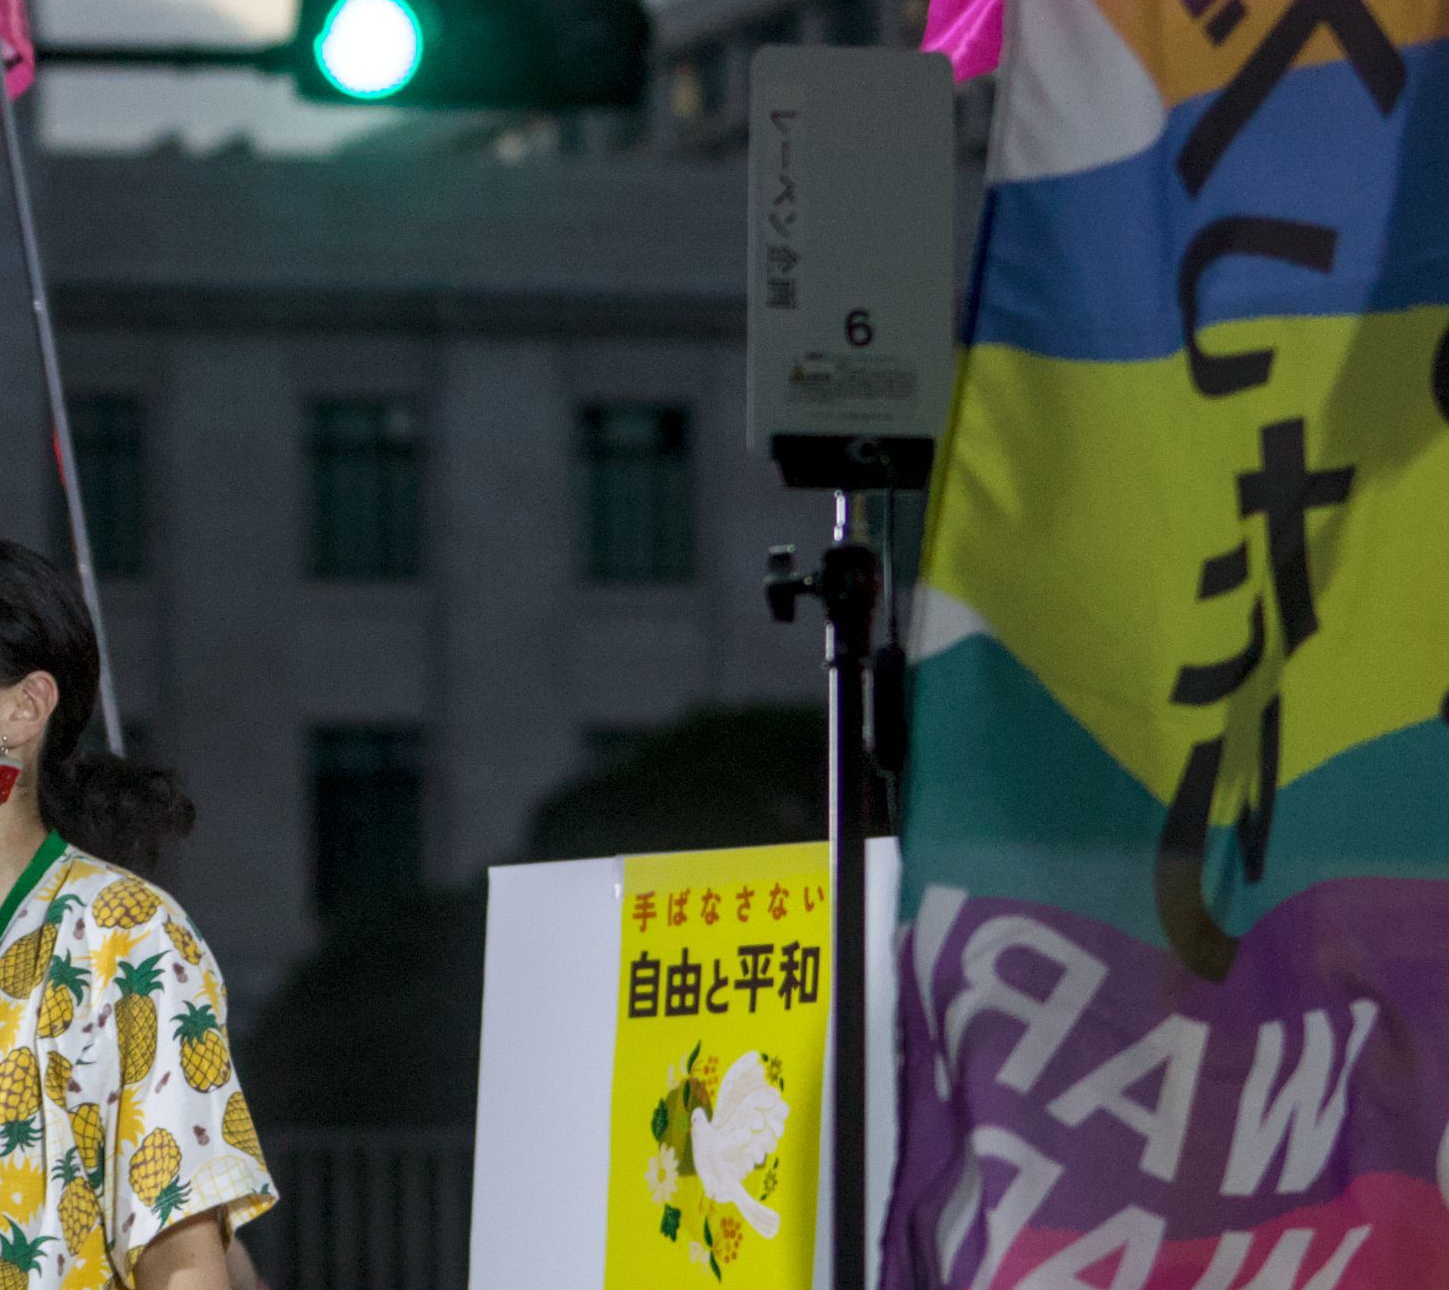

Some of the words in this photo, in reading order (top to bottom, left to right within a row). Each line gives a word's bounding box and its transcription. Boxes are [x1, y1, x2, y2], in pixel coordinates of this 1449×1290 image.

[844, 308, 874, 347] 6
[632, 882, 824, 933] 手ばなさない
[627, 940, 820, 1019] 自由と平和
